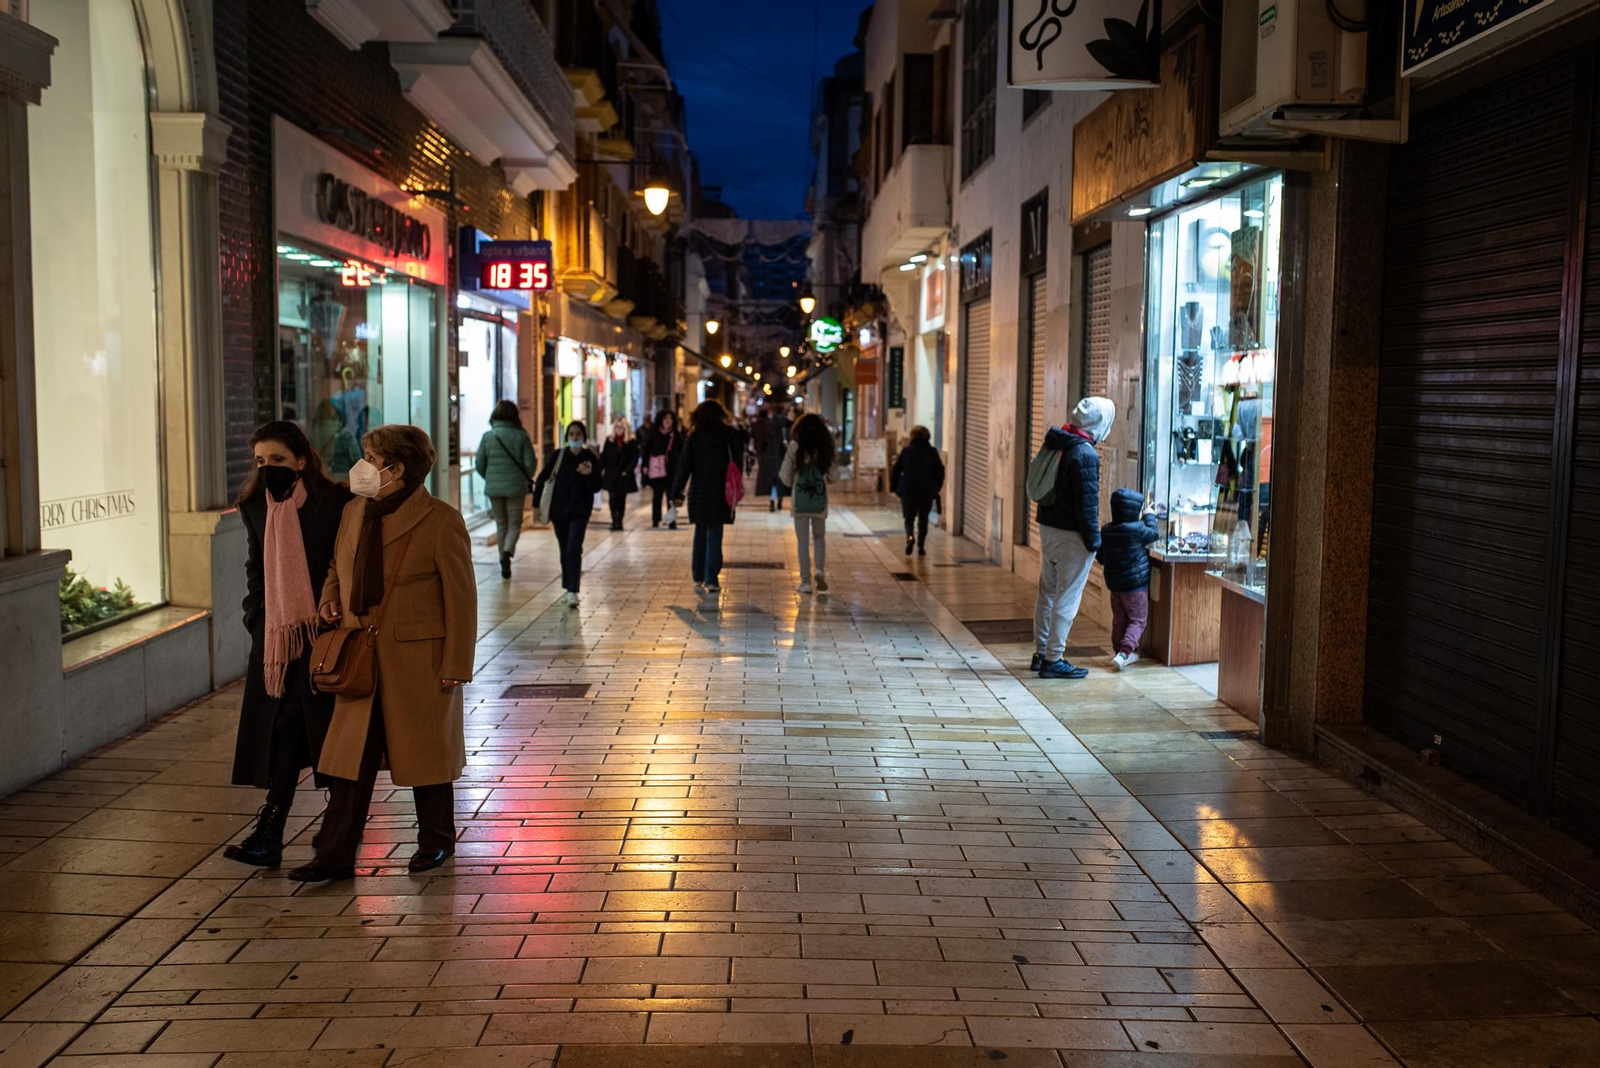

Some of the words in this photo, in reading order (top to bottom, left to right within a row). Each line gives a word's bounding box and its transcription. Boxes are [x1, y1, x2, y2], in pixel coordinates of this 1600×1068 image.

[490, 263, 511, 288] 18
[519, 263, 548, 288] 35
[71, 492, 135, 523] CHRISTMAS
